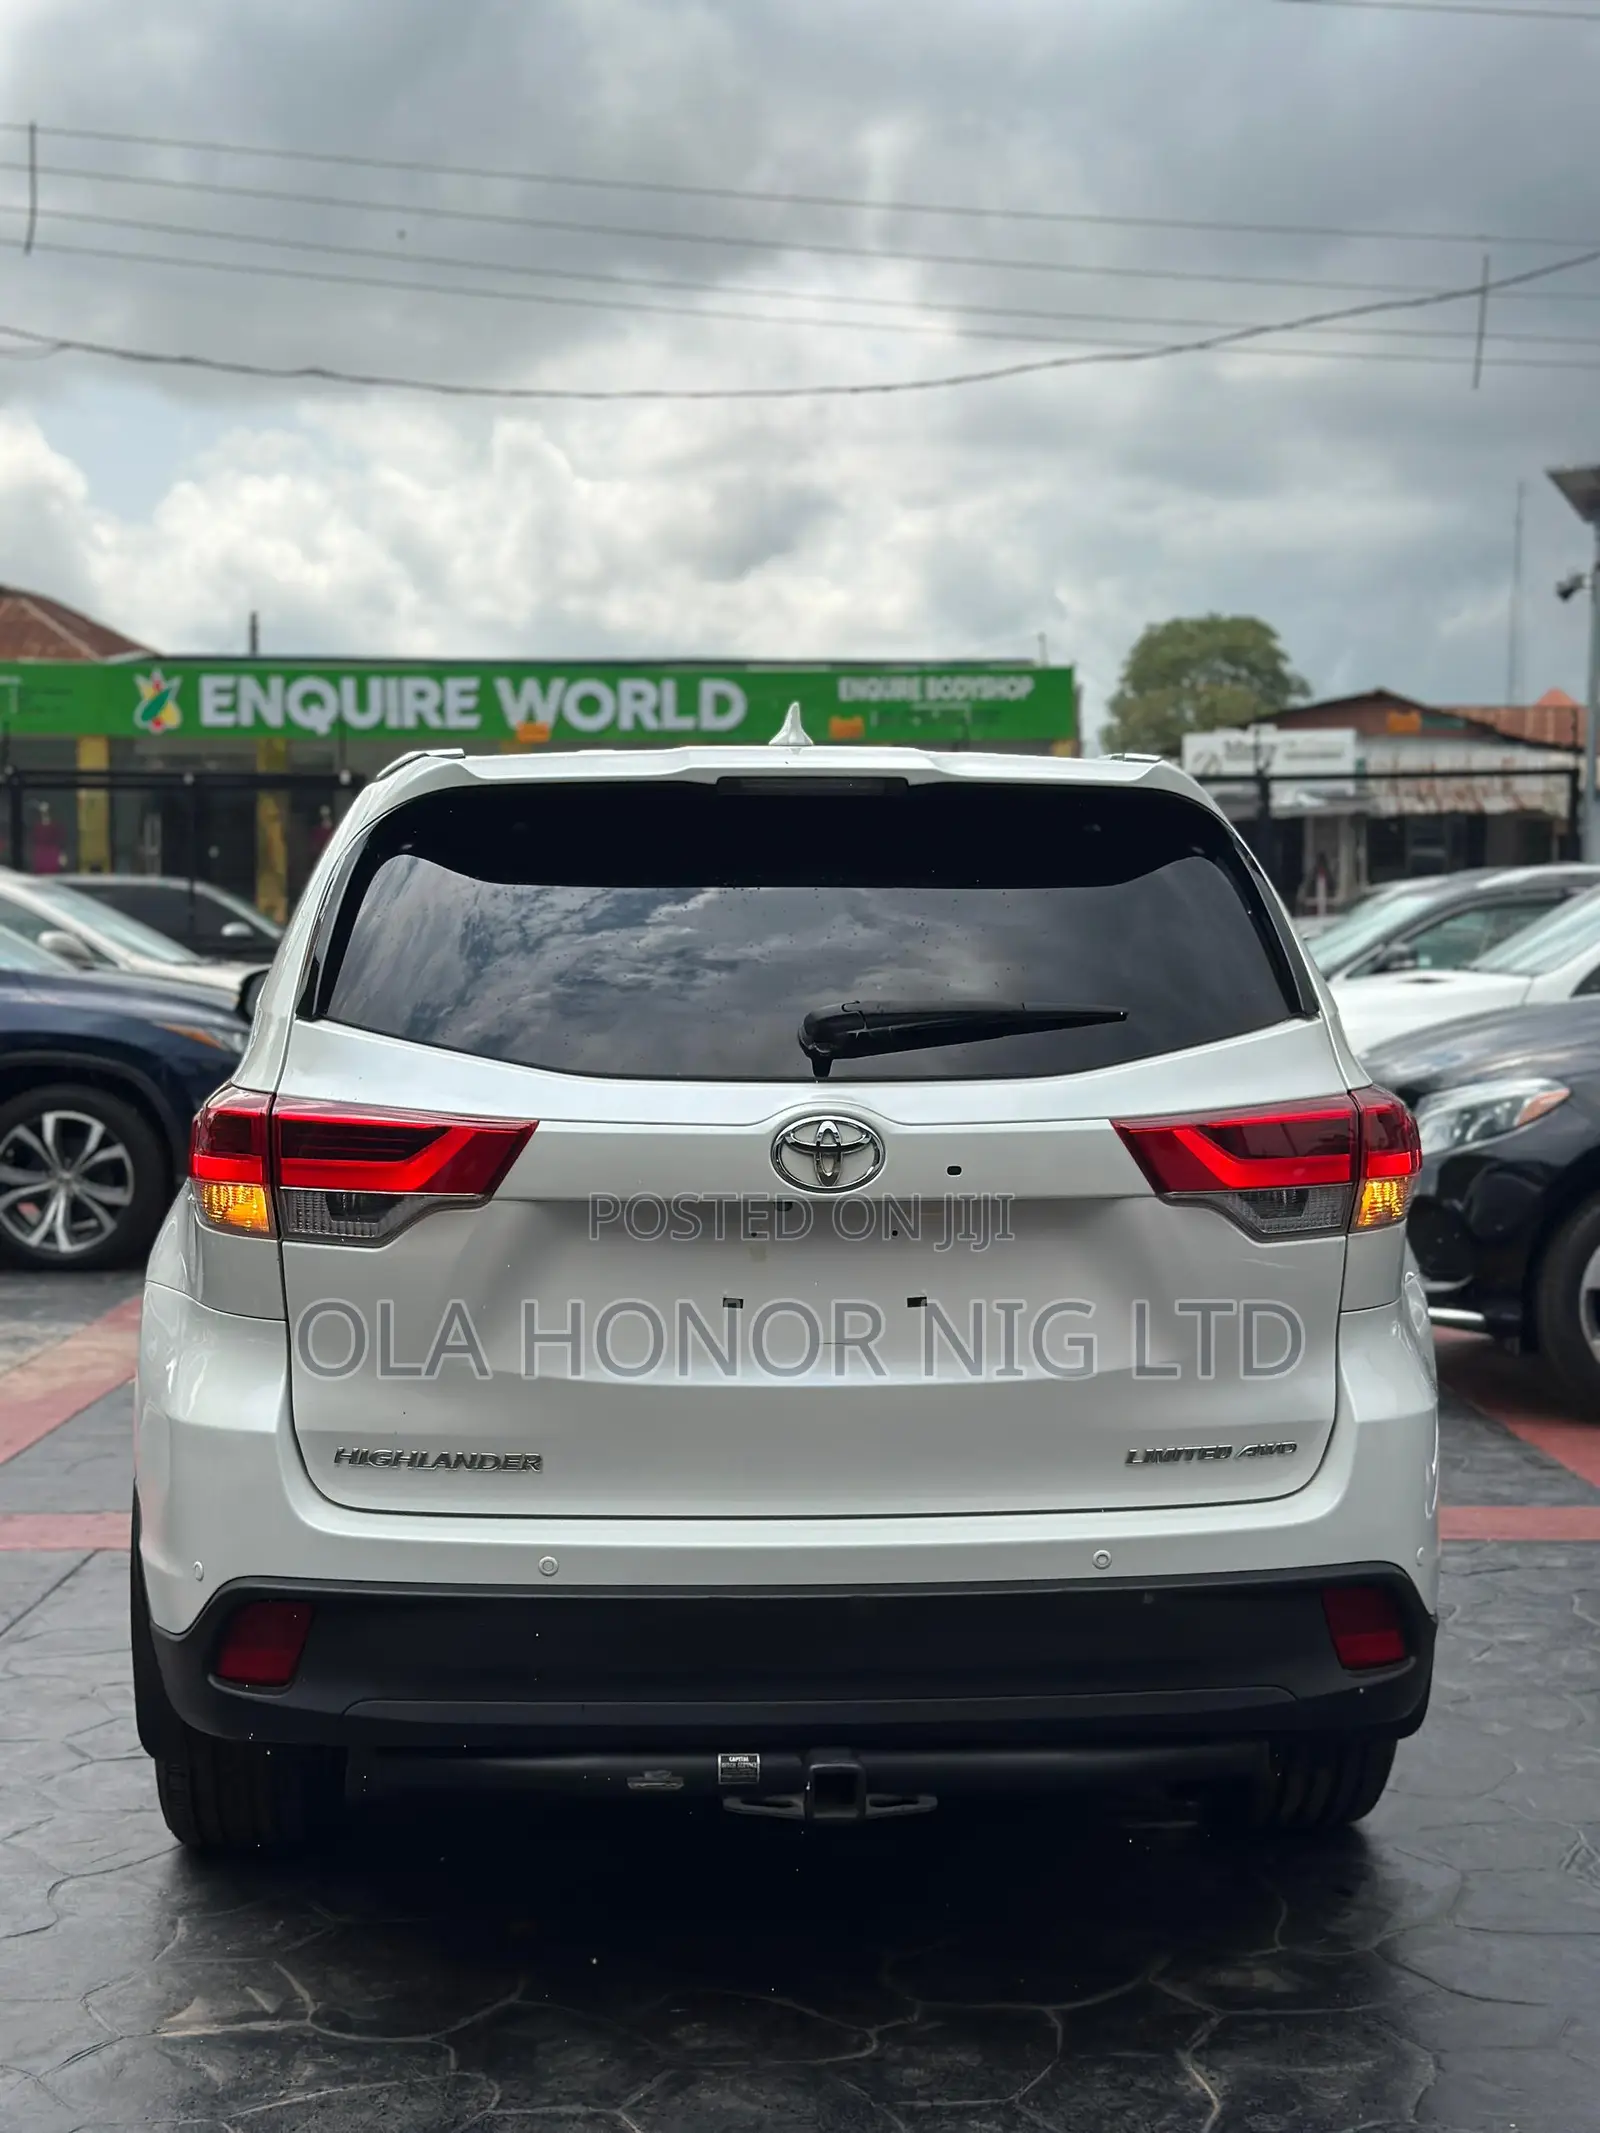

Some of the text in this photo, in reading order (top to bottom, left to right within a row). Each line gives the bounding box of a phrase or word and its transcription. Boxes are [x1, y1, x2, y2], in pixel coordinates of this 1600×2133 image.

[199, 675, 748, 735] ENQUIRE WORLD
[334, 1446, 544, 1473] HIGHLANDER
[1124, 1441, 1298, 1466] LIMITED AWD
